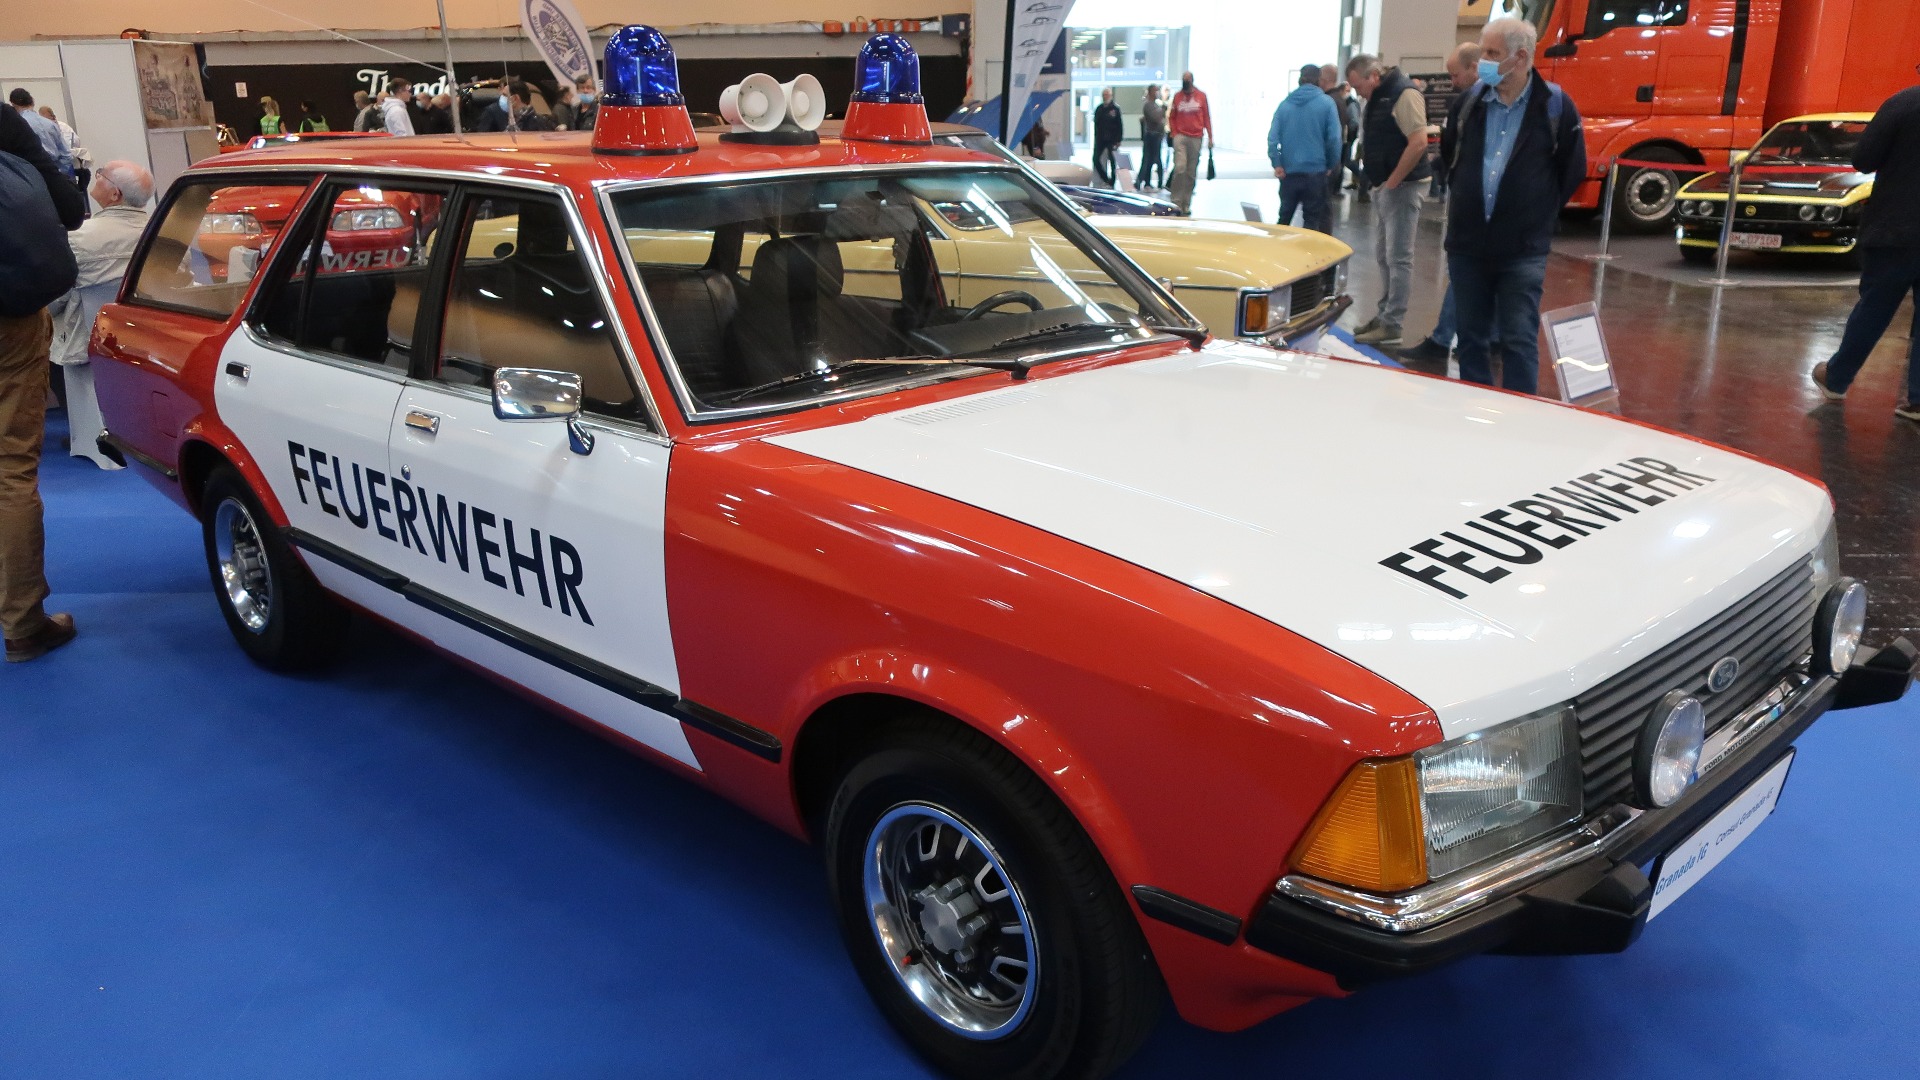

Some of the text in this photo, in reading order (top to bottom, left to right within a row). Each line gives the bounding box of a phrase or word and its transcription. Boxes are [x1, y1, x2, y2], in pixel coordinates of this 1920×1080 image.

[357, 69, 450, 98] Thnd
[287, 440, 595, 627] FEUERWEHR
[1377, 456, 1718, 600] FEUERWEHR
[1704, 720, 1767, 772] FORD MOTORSPORT
[1655, 854, 1697, 896] Granada
[1715, 818, 1741, 846] Consul
